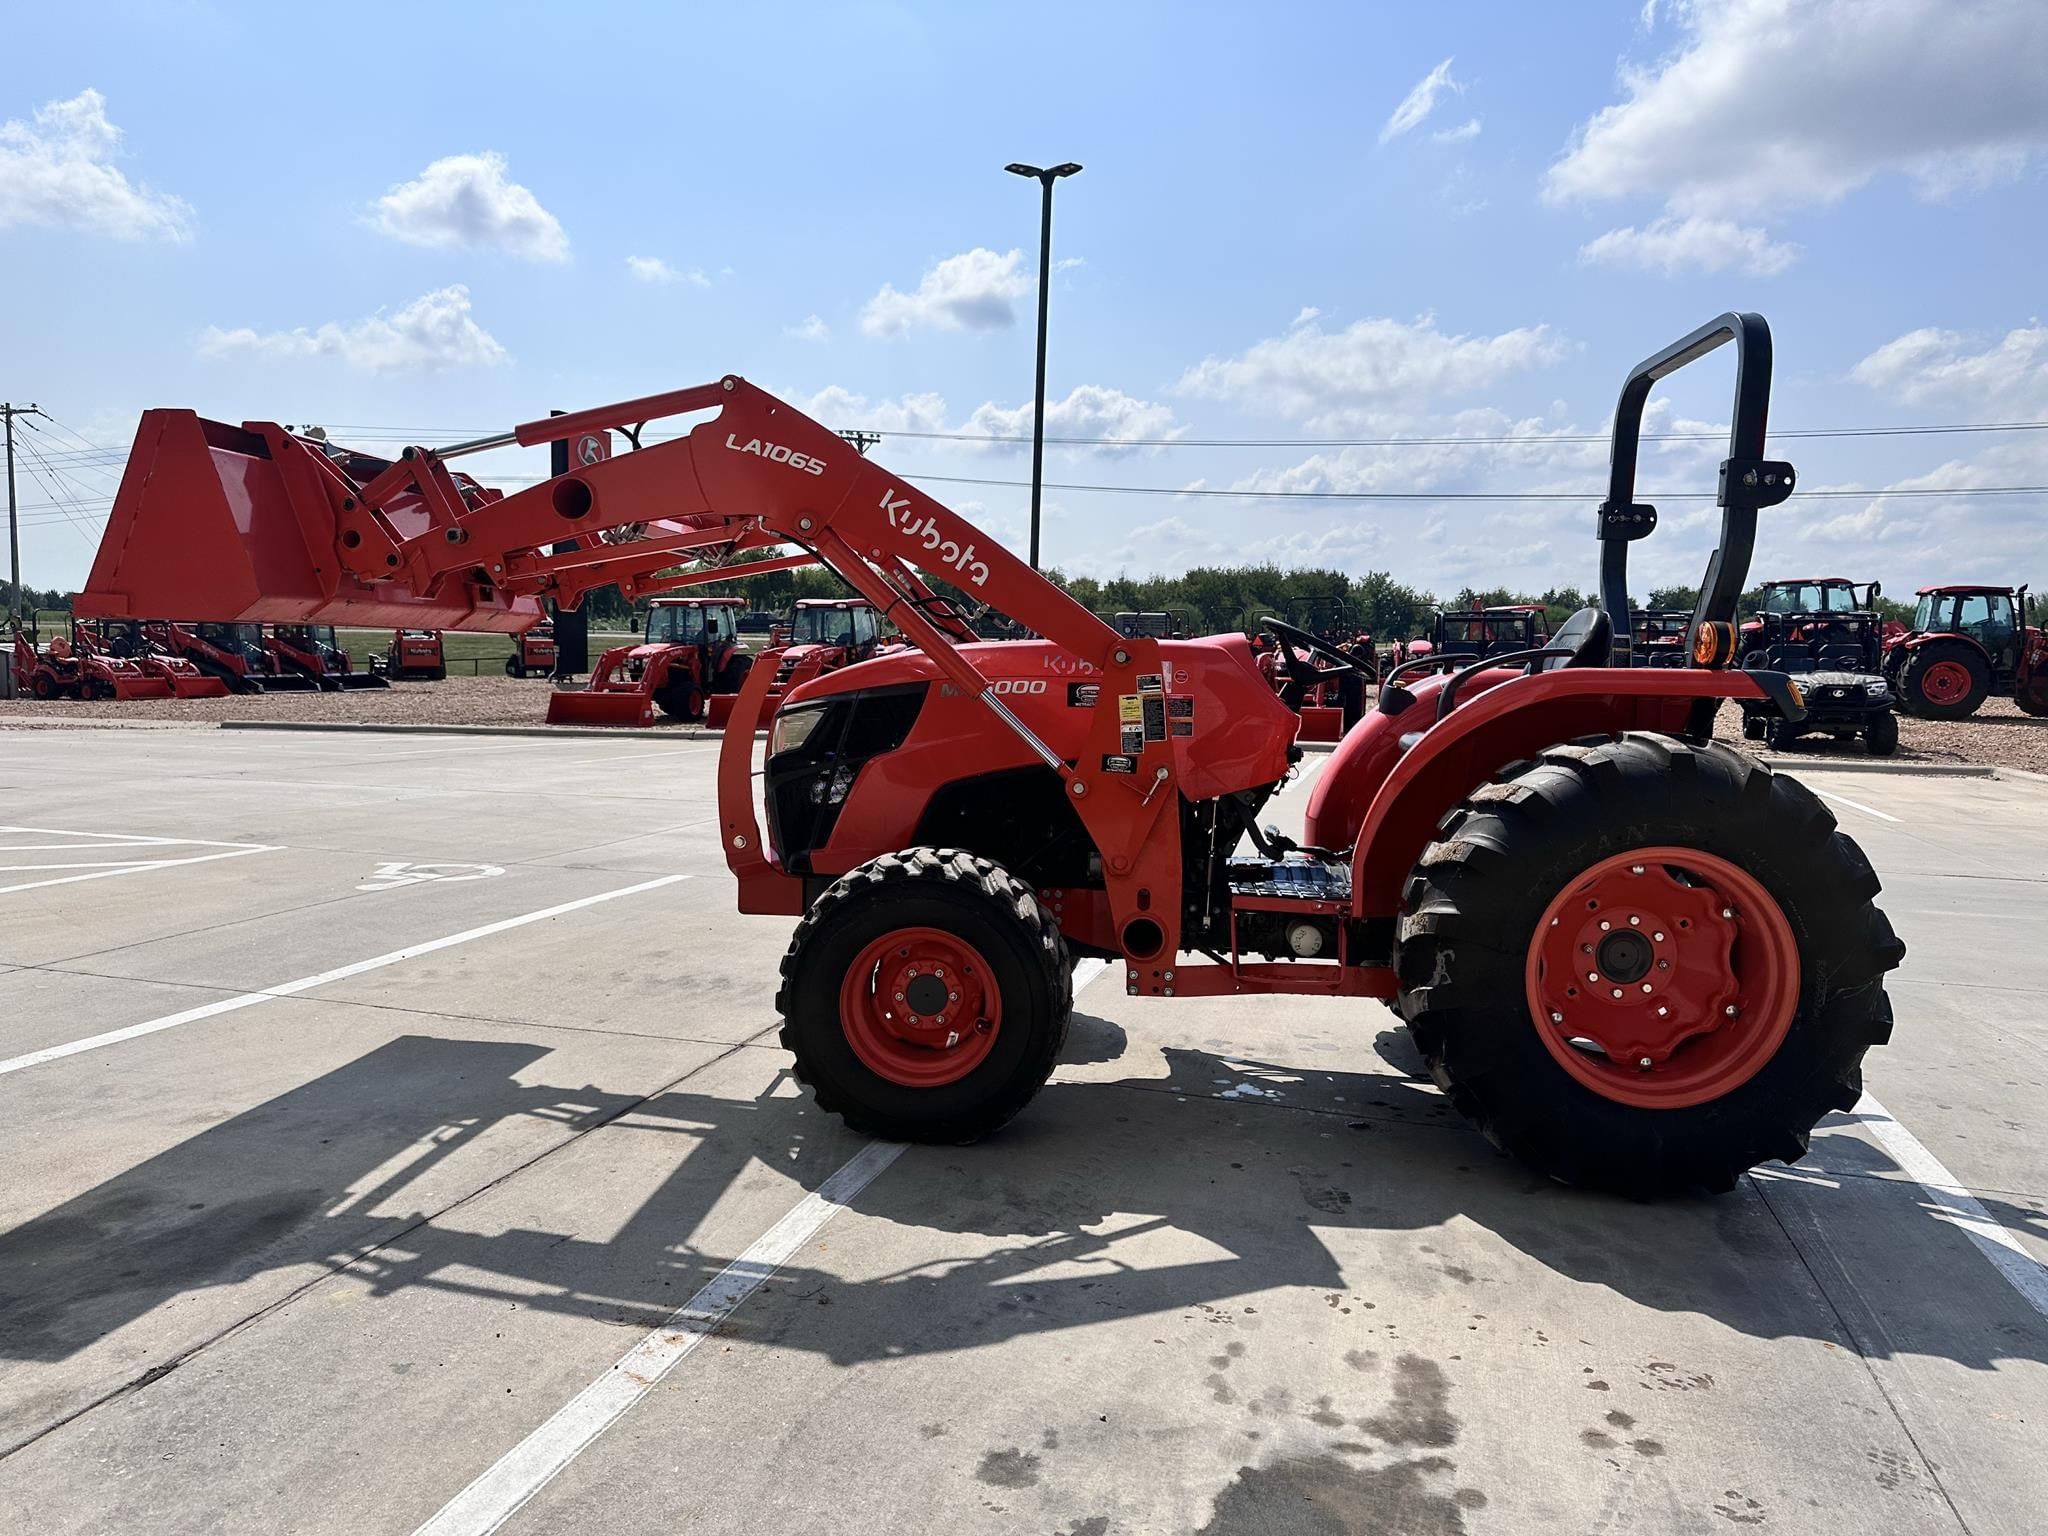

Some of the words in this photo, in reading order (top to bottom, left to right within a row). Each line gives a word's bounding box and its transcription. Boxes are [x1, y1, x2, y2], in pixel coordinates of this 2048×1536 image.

[725, 433, 827, 476] LA1065
[879, 488, 990, 587] Kubota
[1043, 655, 1103, 675] Kub
